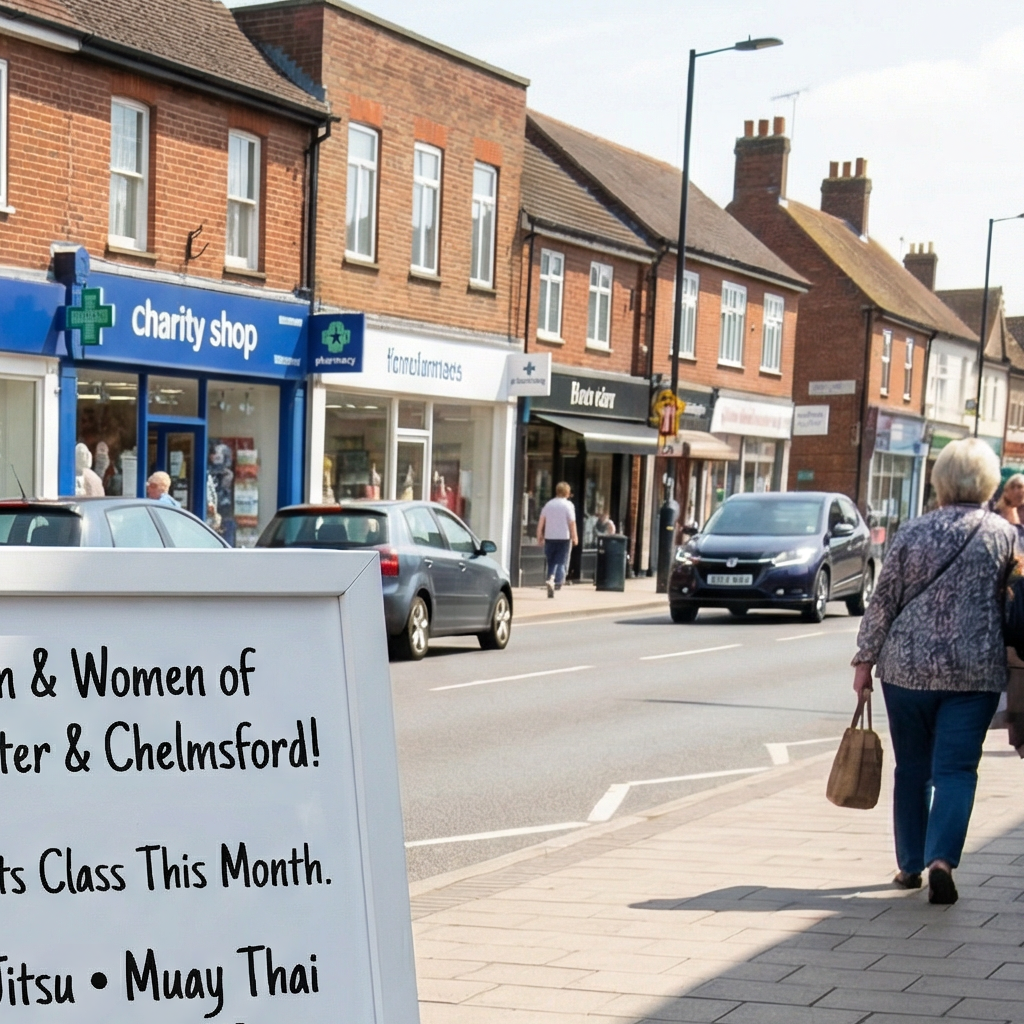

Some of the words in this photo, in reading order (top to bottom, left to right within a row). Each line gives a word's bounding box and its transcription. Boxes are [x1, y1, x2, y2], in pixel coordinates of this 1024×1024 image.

[209, 309, 258, 361] shop
[30, 647, 58, 698] &
[70, 645, 208, 699] Women
[219, 647, 258, 697] of
[64, 722, 92, 774] &
[104, 716, 321, 774] Chelmsford!
[39, 847, 127, 896] Class
[135, 844, 208, 893] This
[219, 841, 334, 891] Month.
[124, 948, 225, 1020] Muay
[236, 944, 320, 997] Thai
